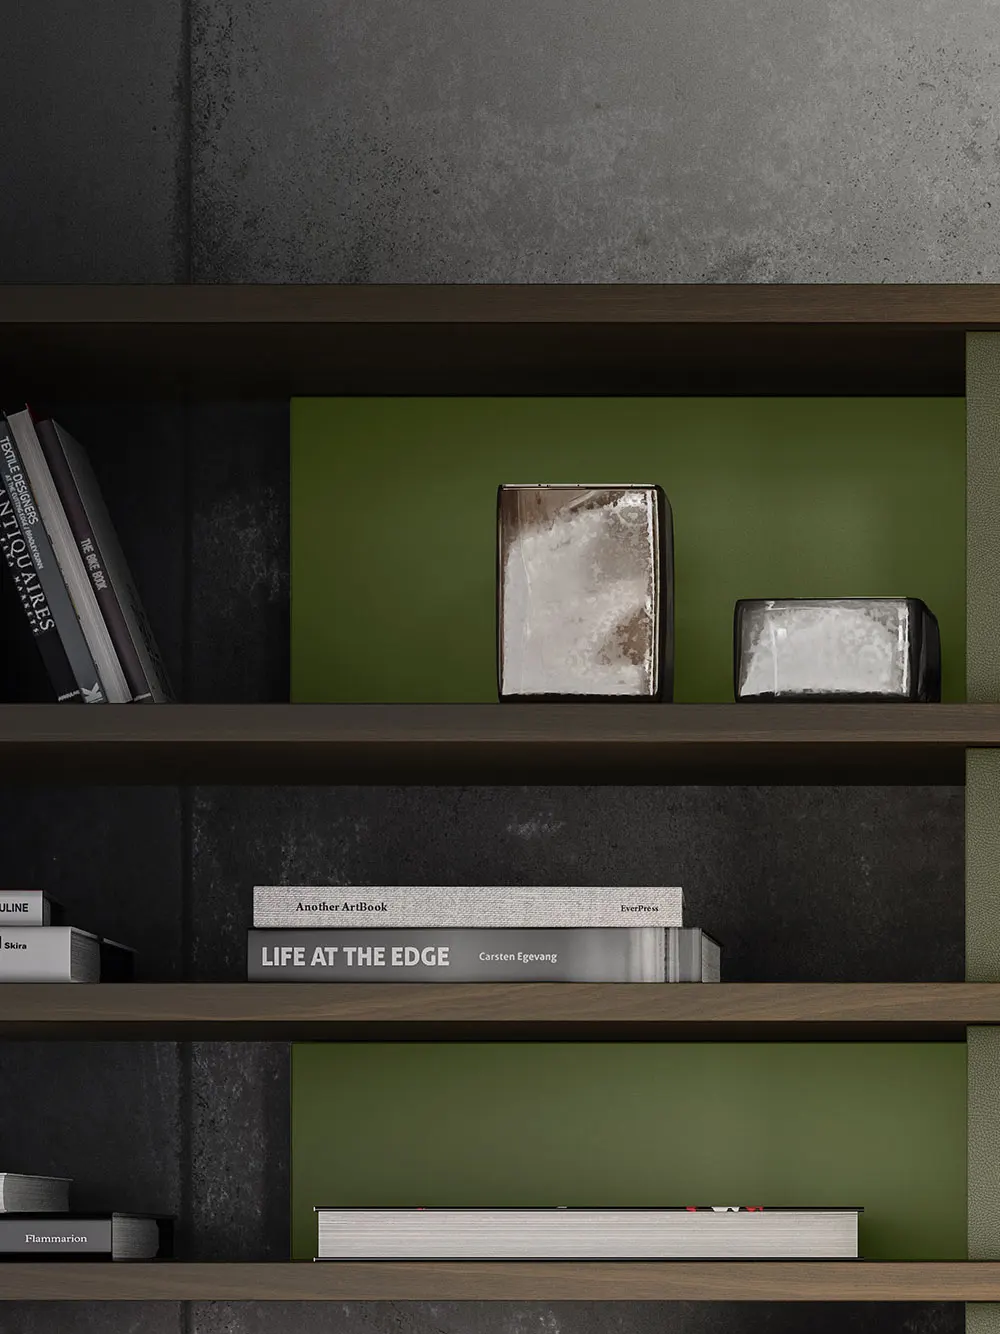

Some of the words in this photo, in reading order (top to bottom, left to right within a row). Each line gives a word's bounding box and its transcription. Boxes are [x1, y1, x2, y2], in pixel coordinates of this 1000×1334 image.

[0, 436, 20, 474] TEXTILE
[12, 473, 38, 525] DESIGNERS
[80, 538, 94, 554] THE
[86, 552, 100, 571] BIKE
[92, 570, 107, 591] BOOK
[296, 902, 340, 912] Another
[342, 902, 388, 913] ArtBook
[621, 905, 659, 913] EverPress
[261, 947, 305, 966] LIFE
[310, 947, 339, 966] AT
[343, 947, 385, 966] THE
[392, 947, 449, 966] EDGE
[479, 951, 515, 962] Carsten
[518, 951, 558, 964] Egevang
[25, 1235, 87, 1243] Flammarion
